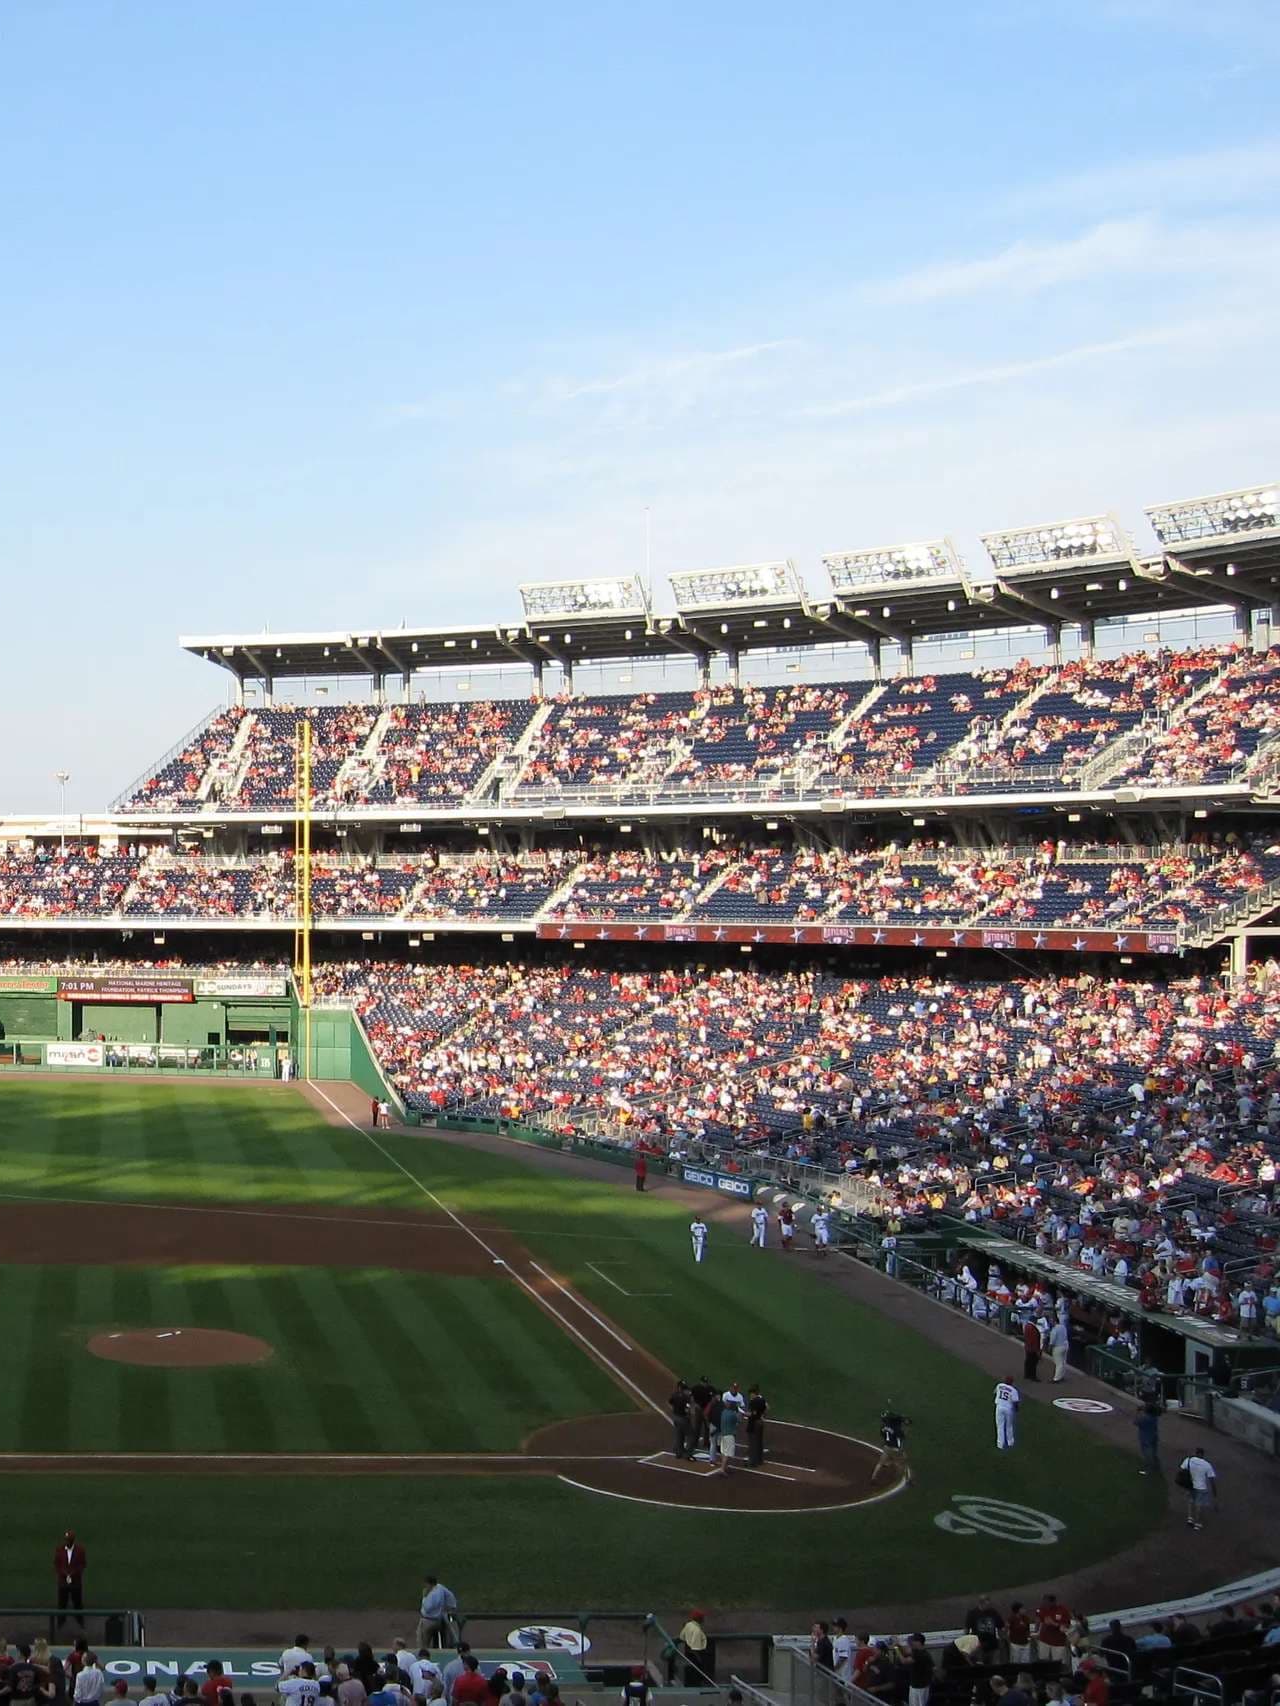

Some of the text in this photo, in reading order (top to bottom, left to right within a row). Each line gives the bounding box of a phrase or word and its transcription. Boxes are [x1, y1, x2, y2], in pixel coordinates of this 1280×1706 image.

[61, 981, 94, 991] 7:01 PM
[217, 983, 252, 991] SUNDAYS
[684, 1169, 750, 1194] GEICO GEICO
